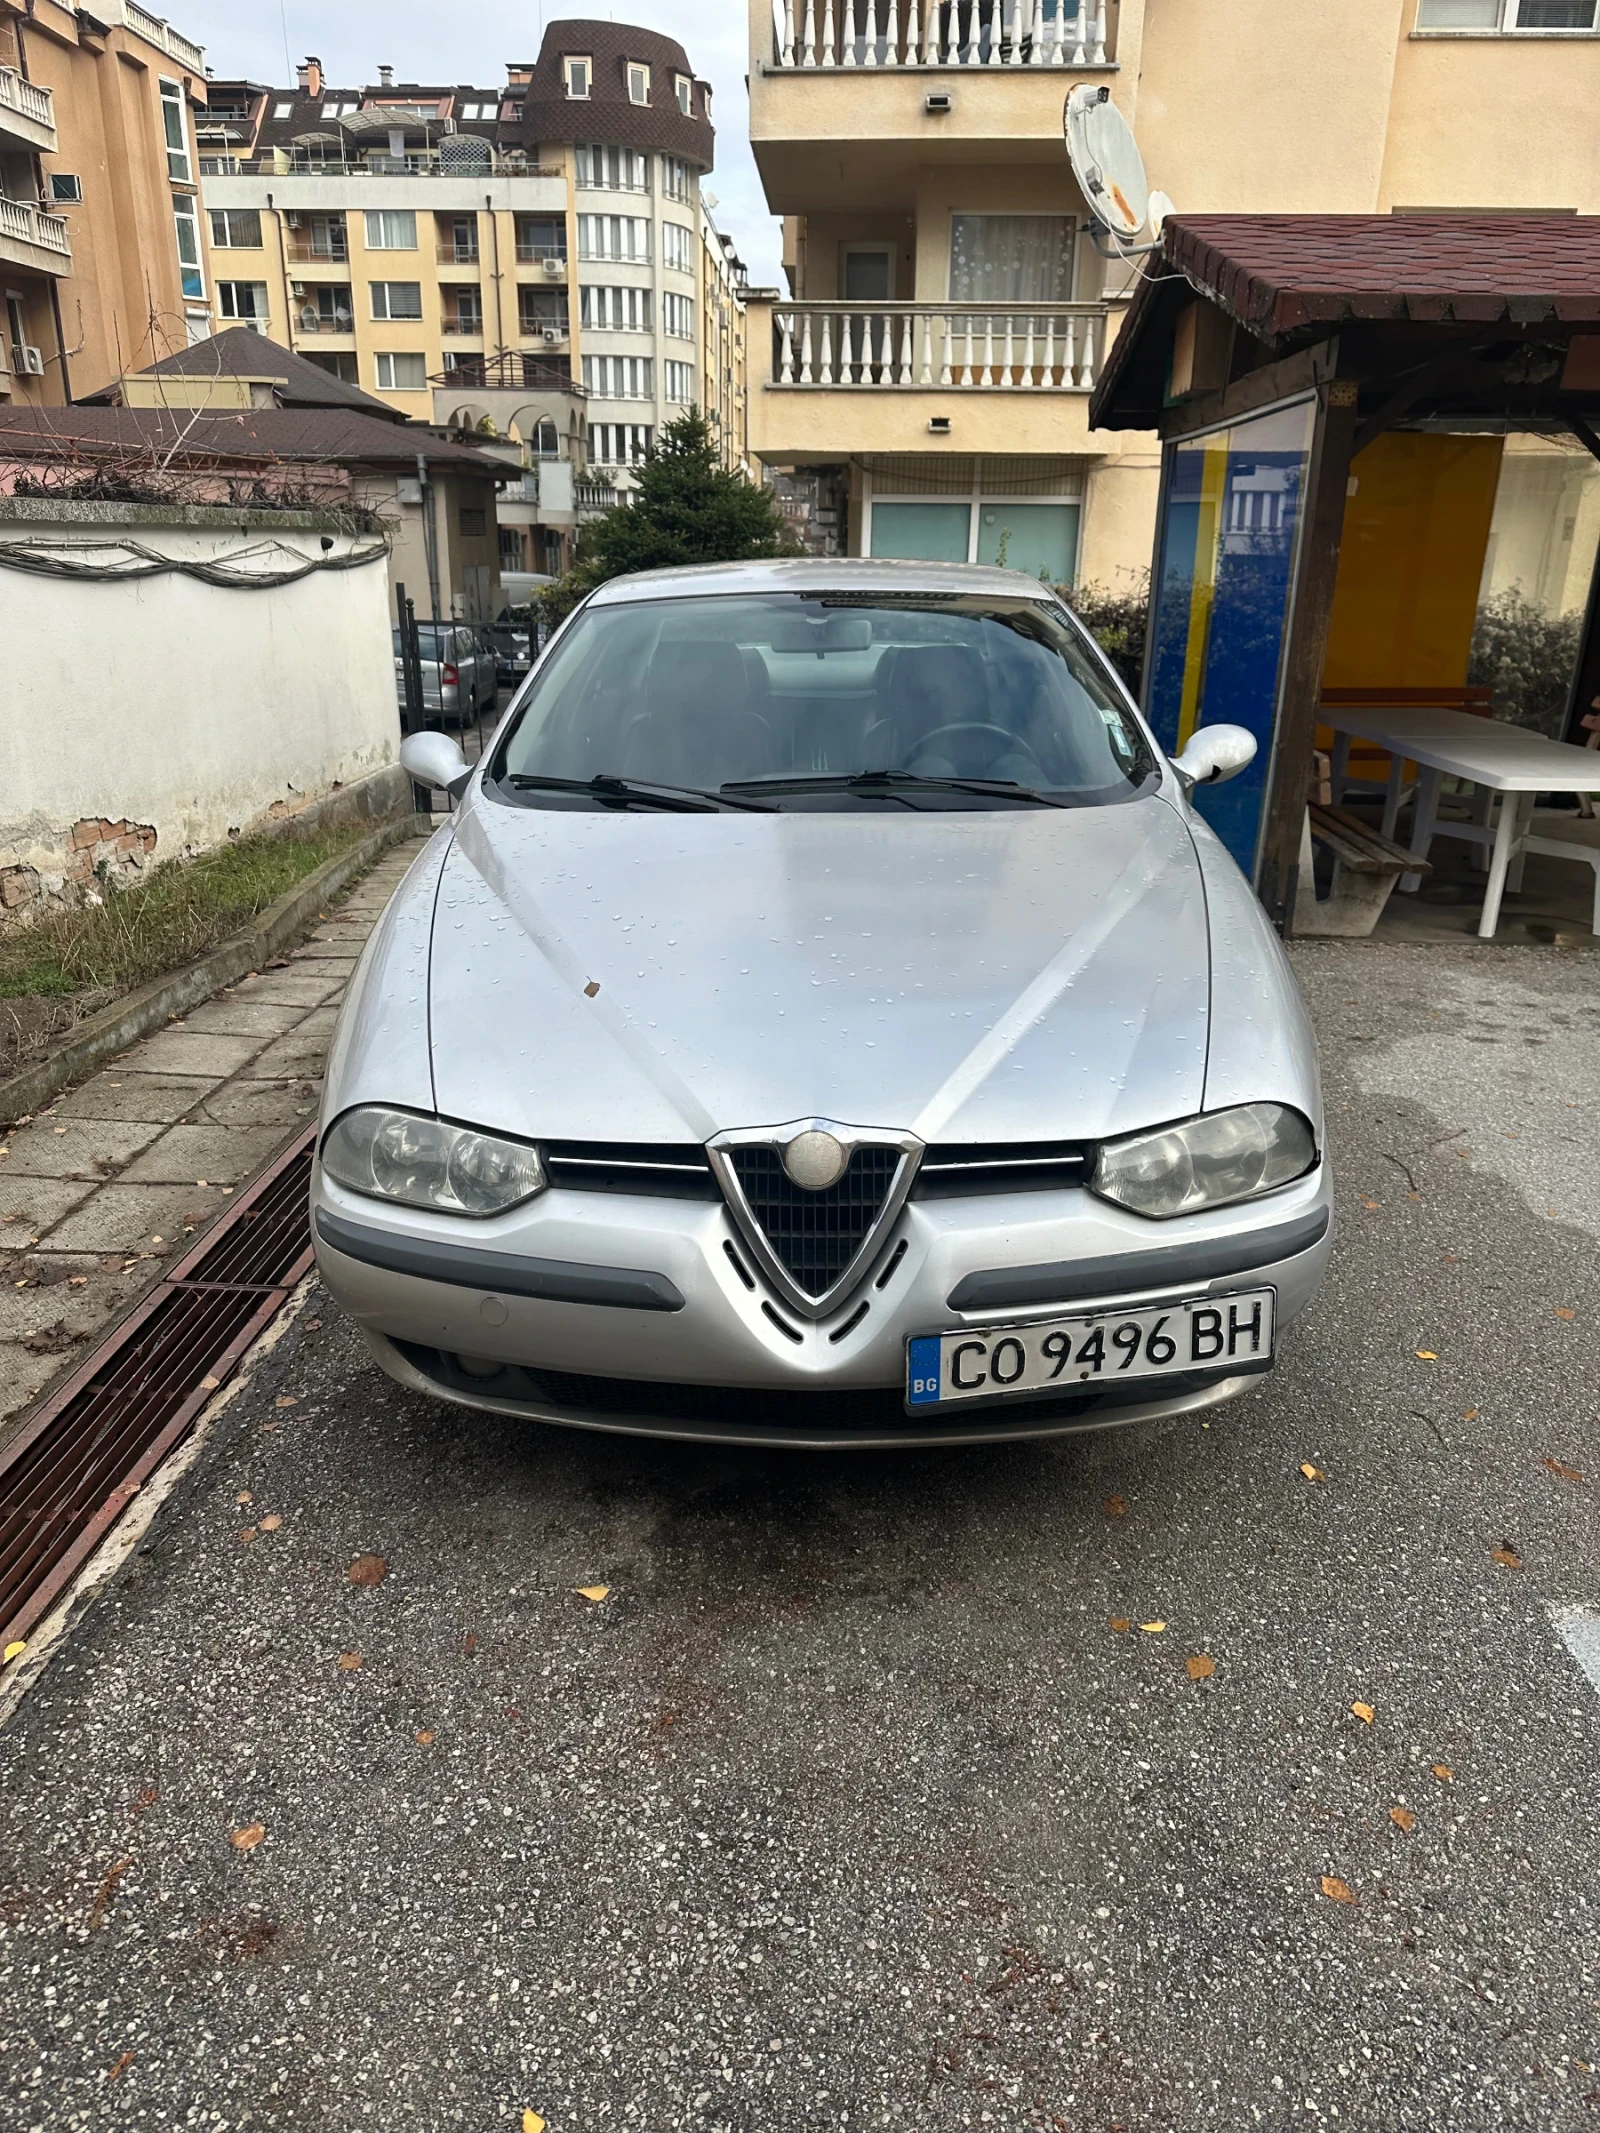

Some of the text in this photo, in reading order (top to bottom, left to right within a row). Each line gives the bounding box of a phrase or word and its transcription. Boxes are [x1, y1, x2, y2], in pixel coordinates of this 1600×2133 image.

[951, 1300, 1262, 1390] CO 9496 BH
[913, 1377, 938, 1395] BG
